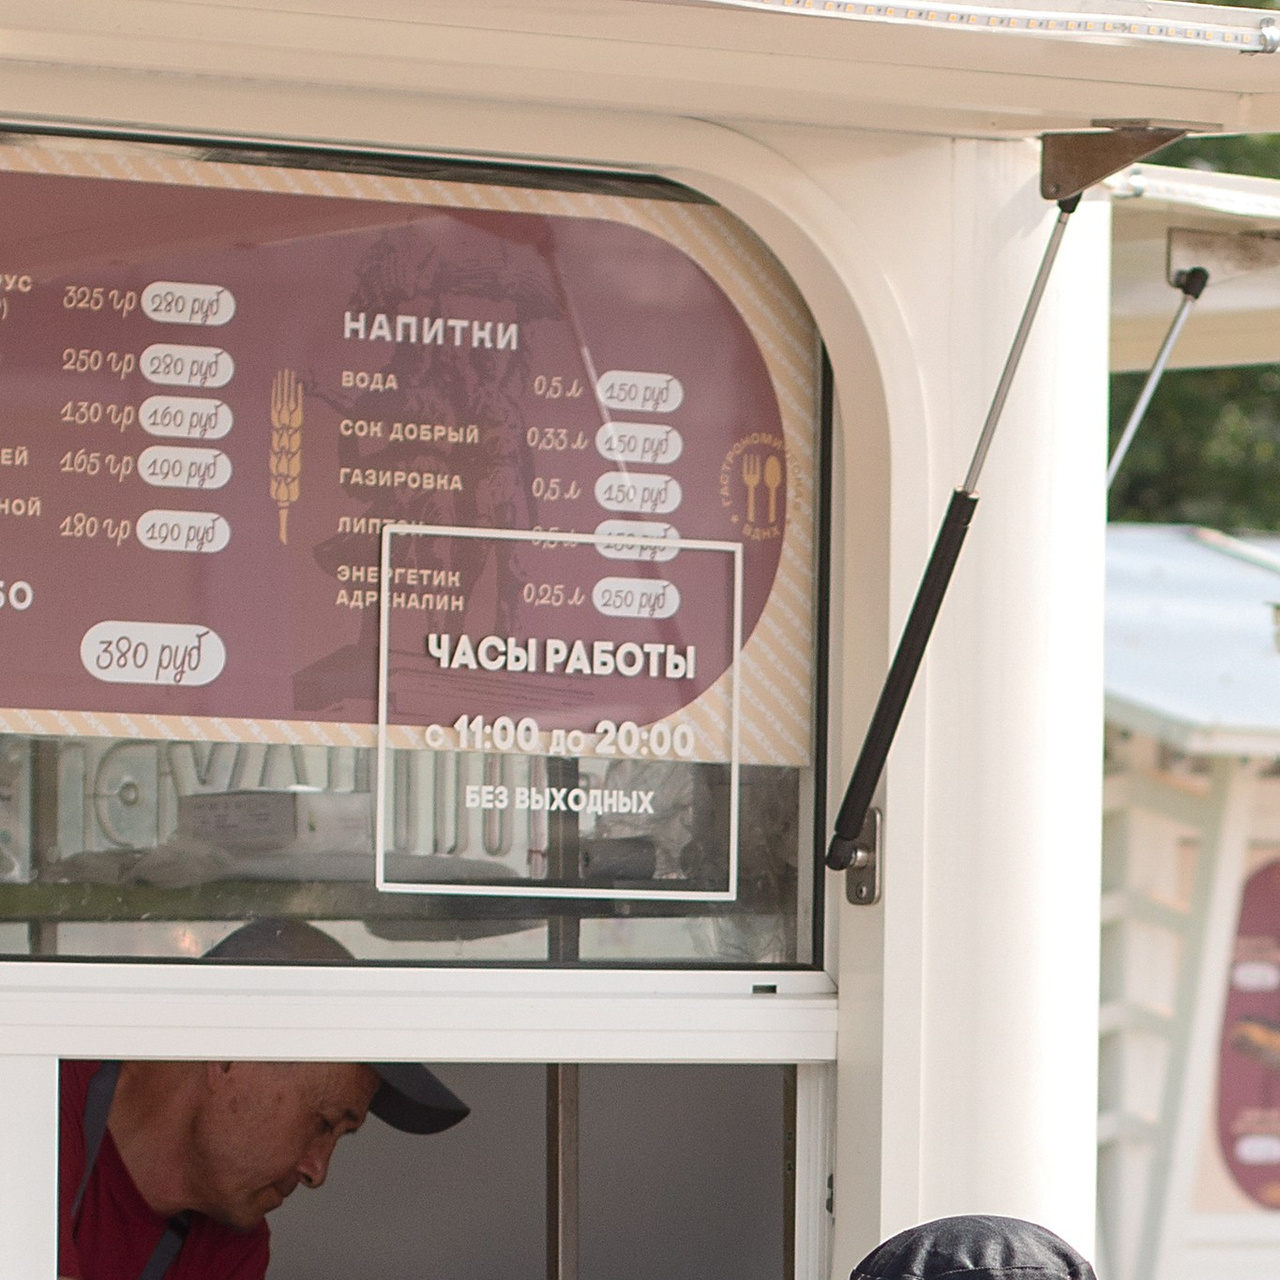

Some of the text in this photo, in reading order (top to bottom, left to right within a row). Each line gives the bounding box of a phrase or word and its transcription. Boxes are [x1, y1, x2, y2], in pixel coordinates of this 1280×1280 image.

[0, 273, 32, 293] УС
[63, 285, 104, 311] 325
[151, 291, 185, 314] 280
[188, 287, 225, 324] руб
[343, 311, 519, 350] НАПИТКИ
[62, 347, 102, 373] 250
[150, 353, 184, 377] 280
[187, 349, 225, 385] руб
[341, 370, 399, 392] ВОДА
[533, 374, 562, 399] 0,5
[604, 382, 638, 400] 150
[641, 376, 675, 412] руб
[60, 400, 101, 426] 130
[148, 405, 183, 428] 160
[187, 402, 224, 438] руб
[339, 418, 384, 438] СОК
[388, 422, 480, 444] ДОБРЫЙ
[525, 425, 569, 451] 0,33
[604, 434, 638, 452] 150
[640, 428, 675, 464] руб
[59, 448, 101, 476] 165
[146, 456, 183, 481] 190
[185, 451, 223, 488] руб
[339, 467, 464, 491] ГАЗИРОВКА
[532, 477, 562, 502] 0,5
[602, 484, 637, 504] 150
[640, 478, 674, 512] руб
[59, 511, 99, 538] 180
[145, 522, 181, 546] 190
[184, 516, 222, 553] руб
[336, 589, 465, 611] АДРНАЛИН
[522, 582, 566, 607] 0,25
[600, 588, 635, 609] 250
[637, 583, 672, 617] руб
[96, 631, 210, 684] 380 руб
[427, 633, 696, 680] ЧАСЫ РАБОТЫ
[453, 714, 540, 752] 11:00
[595, 720, 696, 758] 20:00
[465, 784, 655, 816] БЕЗ ВЫХОДНЫХ
